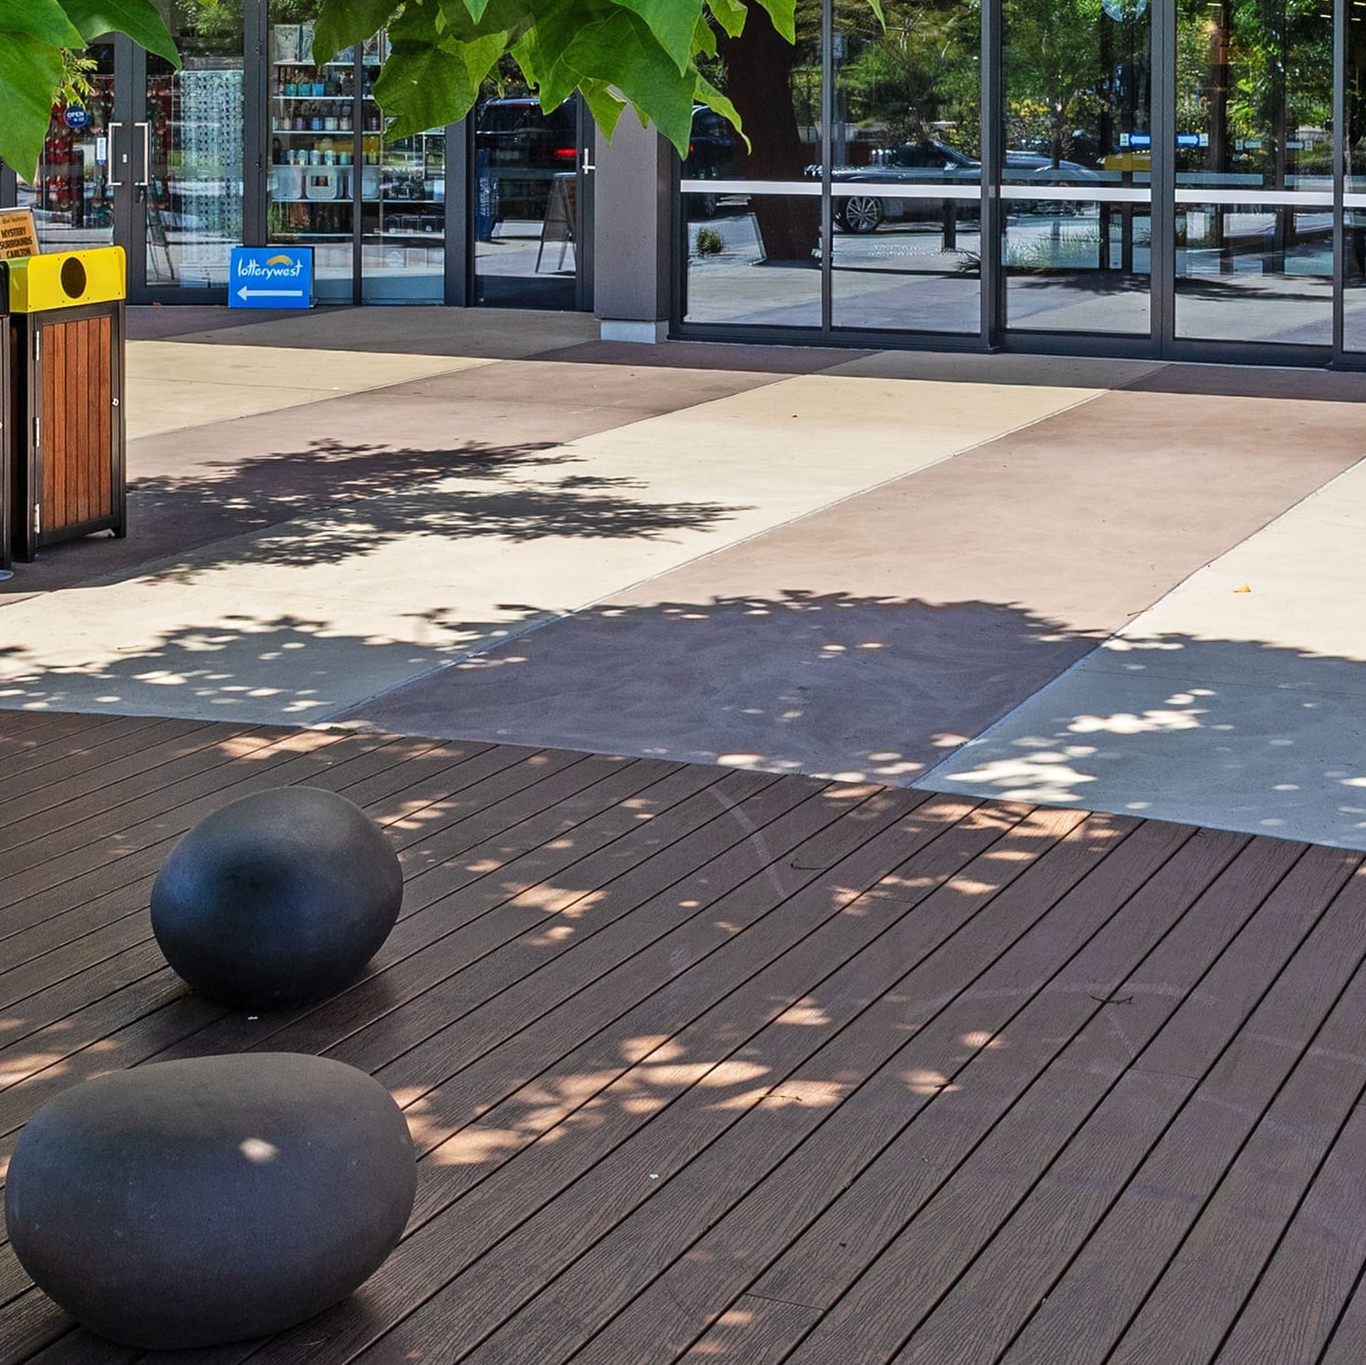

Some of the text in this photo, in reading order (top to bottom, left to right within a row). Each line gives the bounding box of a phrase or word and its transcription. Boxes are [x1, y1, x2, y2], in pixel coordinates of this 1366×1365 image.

[1, 226, 27, 238] MYSTERY
[0, 236, 33, 250] SURROUNDS
[237, 257, 304, 280] lotterywest
